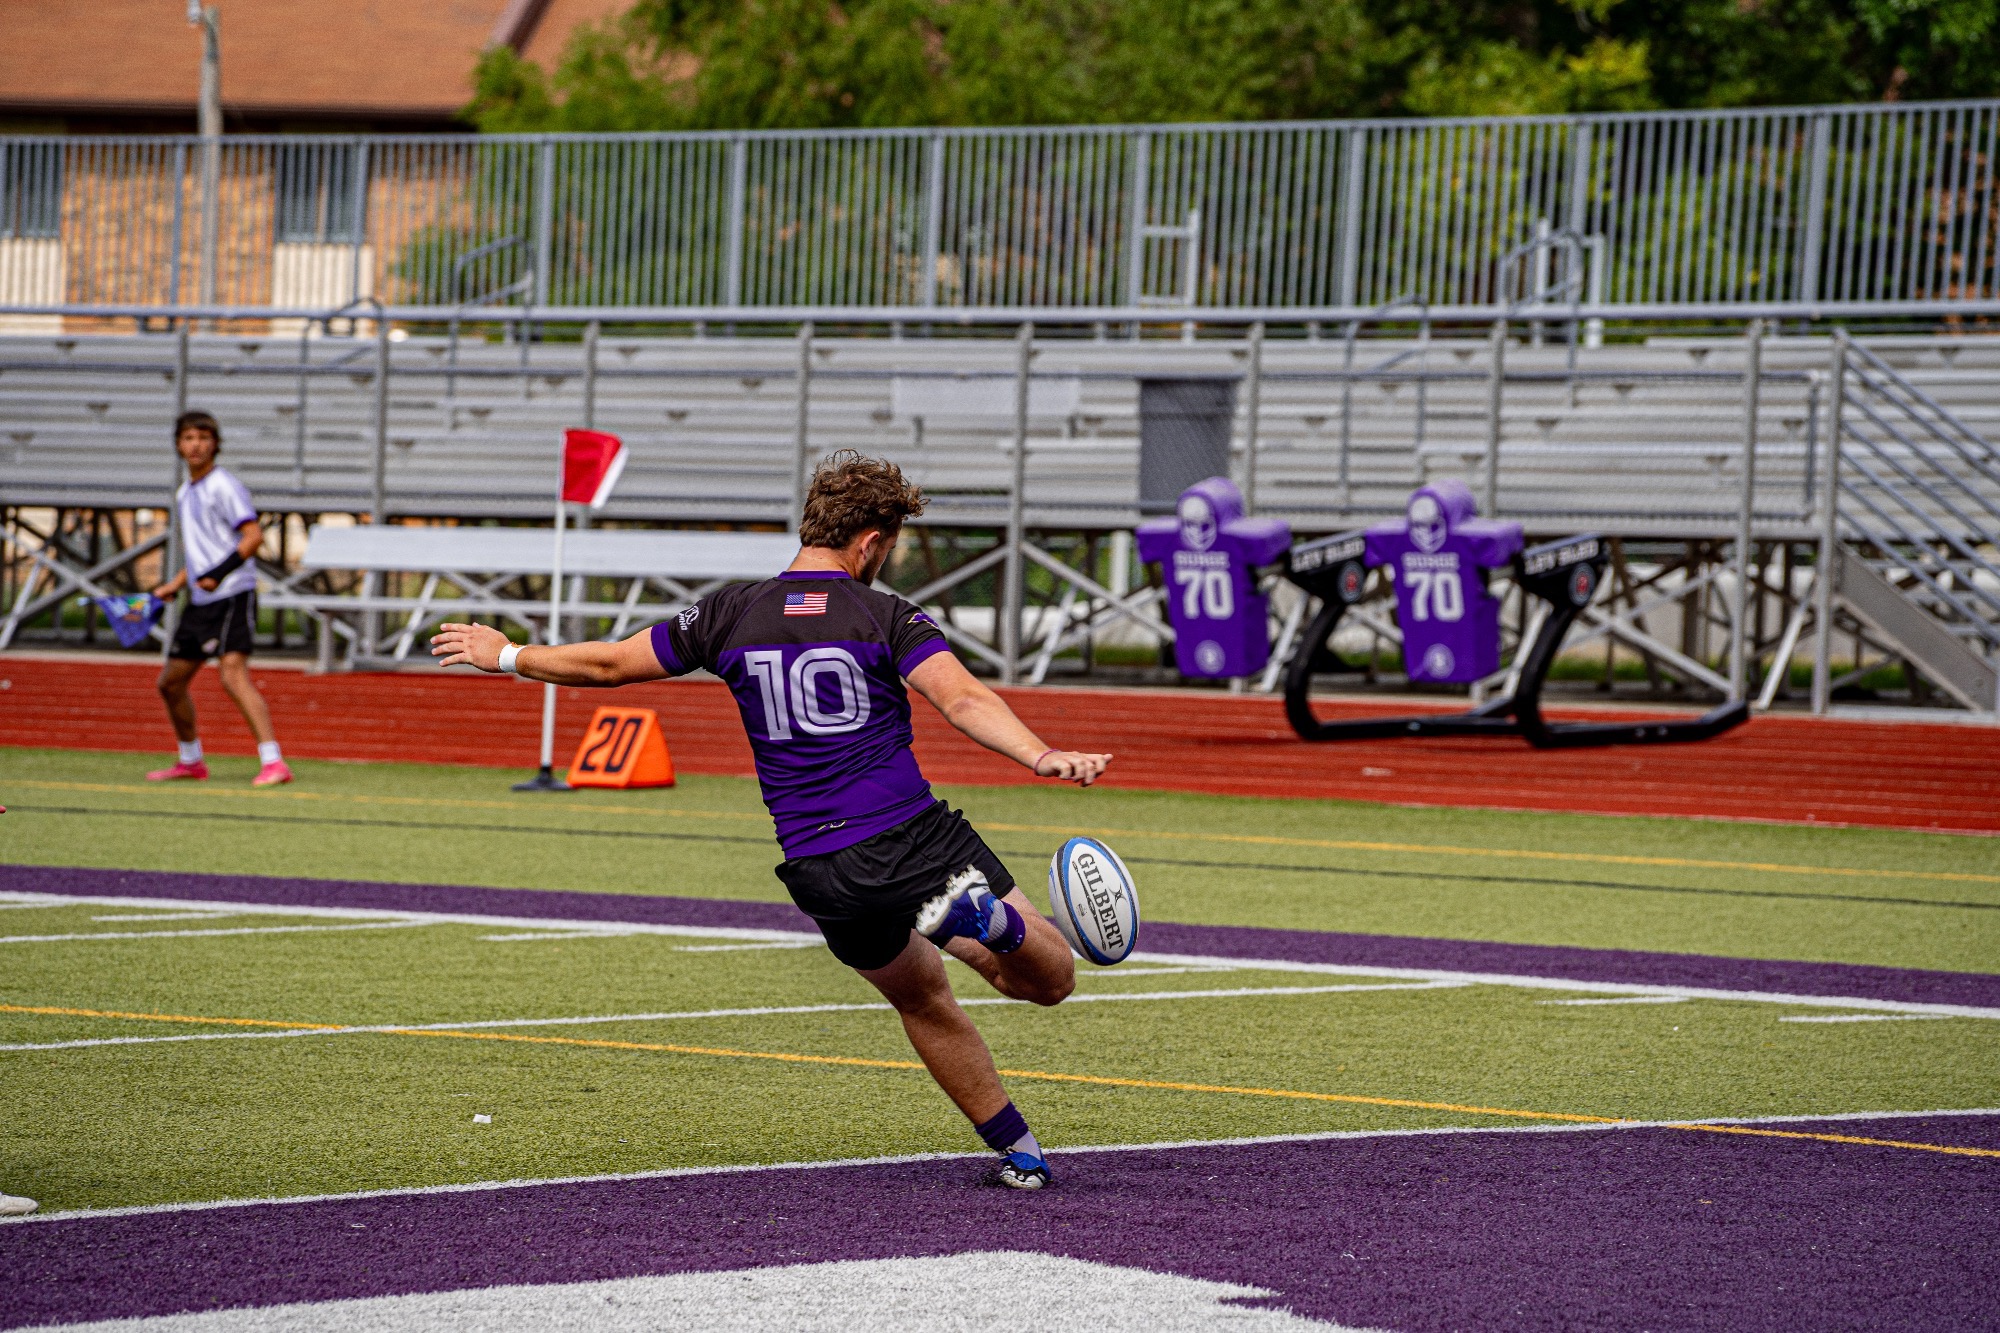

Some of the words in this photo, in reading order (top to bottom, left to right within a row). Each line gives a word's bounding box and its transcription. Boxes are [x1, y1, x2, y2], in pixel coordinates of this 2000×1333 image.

[1175, 570, 1234, 619] 70
[1403, 572, 1464, 622] 70
[744, 647, 870, 740] 10
[580, 717, 642, 772] 20
[1077, 853, 1124, 949] GILBERT
